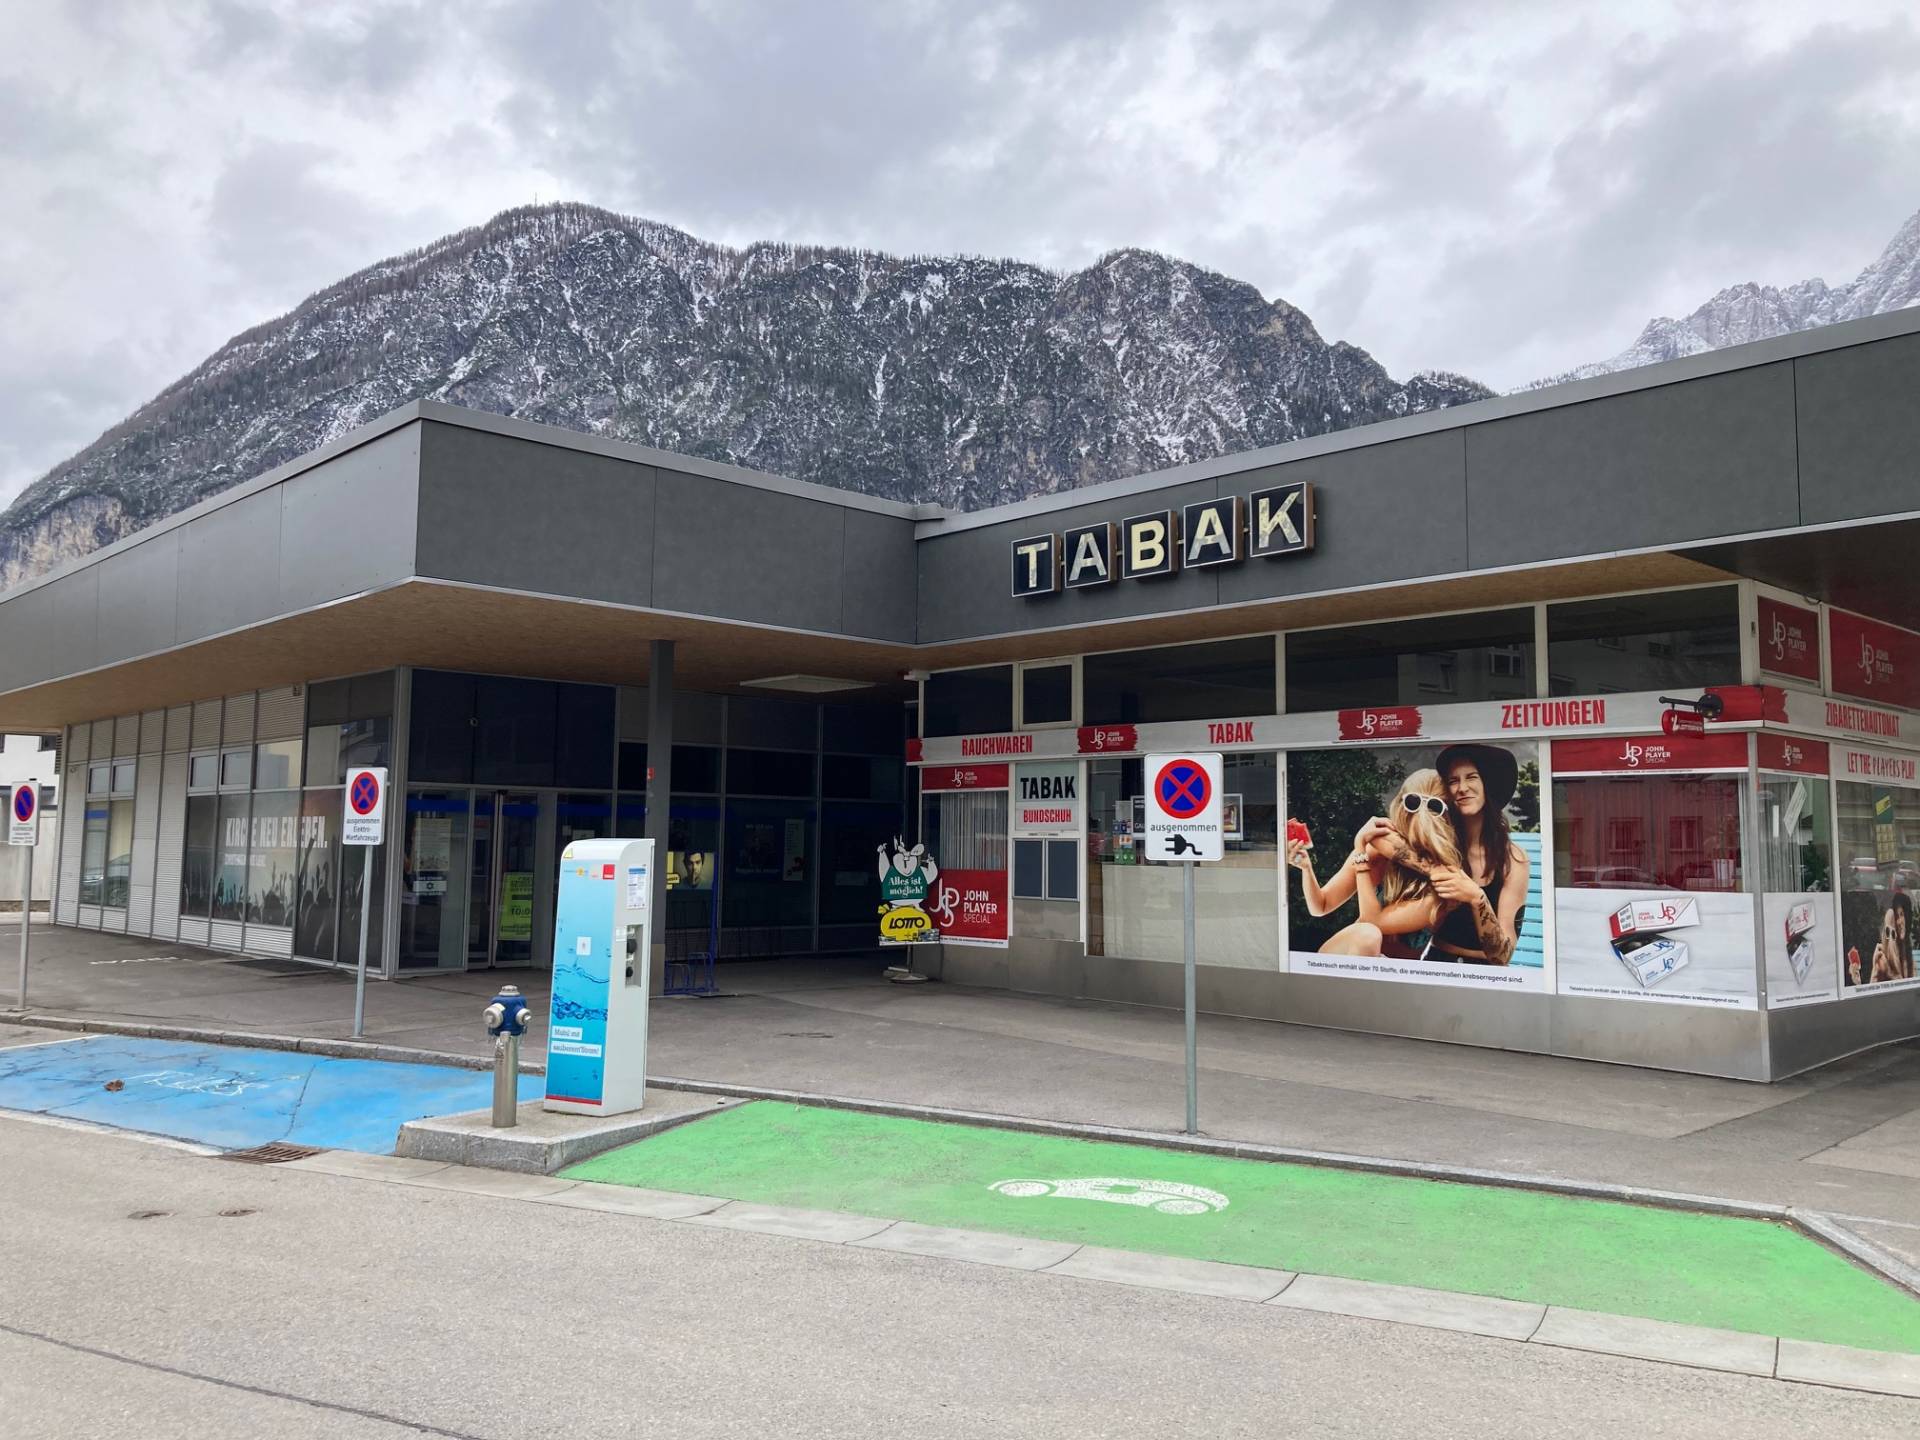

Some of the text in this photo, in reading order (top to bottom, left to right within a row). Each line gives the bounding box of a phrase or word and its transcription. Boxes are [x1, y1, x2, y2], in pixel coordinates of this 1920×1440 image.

[1017, 491, 1301, 588] TABAK
[1787, 626, 1802, 637] JOHN
[1788, 638, 1807, 650] PLAYER
[1876, 650, 1888, 661] JOHN
[1876, 660, 1893, 674] PLAYER
[1501, 699, 1606, 729] ZEITUNGEN
[1825, 702, 1899, 737] ZIGARETTENAUTOMAT
[1380, 719, 1403, 727] PLAYER
[1208, 722, 1254, 744] TABAK
[962, 735, 1032, 757] RAUCHWAREN
[1847, 752, 1858, 773] LET
[1859, 753, 1871, 774] THE
[1020, 776, 1076, 799] TABAK
[1023, 809, 1072, 823] BUNDSCHUH
[225, 817, 258, 848] KIRCE
[1150, 823, 1217, 833] ausgenommen
[888, 877, 921, 886] Alles ist
[889, 885, 923, 896] möglich!
[963, 890, 989, 901] JOHN
[963, 902, 998, 914] PLAYER
[889, 917, 925, 929] LOTTO
[963, 914, 991, 924] SPECIAL
[1307, 960, 1523, 983] Tabakrauch enthält über 70 Stoffe, die erwiesenermaßen krebserregend sind.
